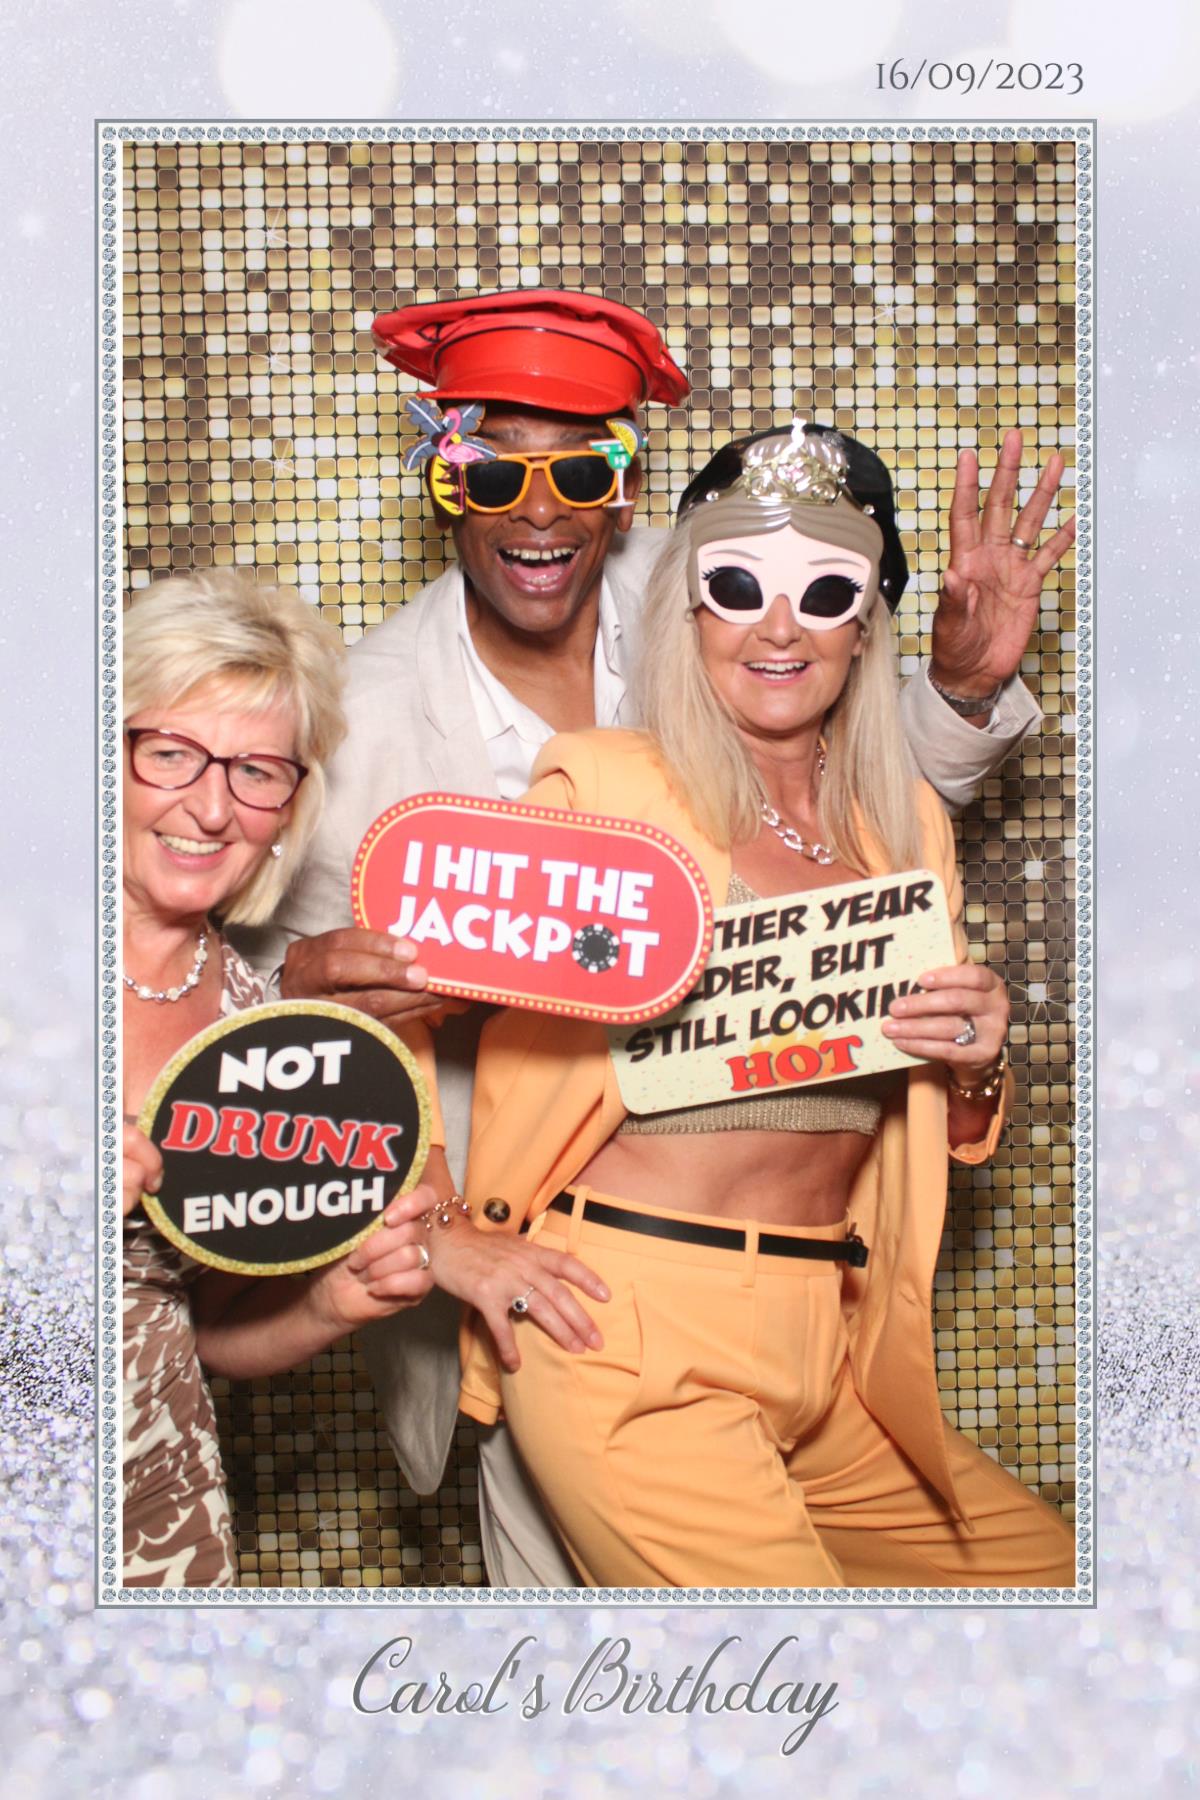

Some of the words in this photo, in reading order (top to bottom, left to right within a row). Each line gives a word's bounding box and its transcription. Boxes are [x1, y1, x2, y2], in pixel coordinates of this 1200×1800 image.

[403, 841, 423, 886] I
[433, 844, 529, 900] HIT
[541, 860, 654, 921] THE
[821, 880, 935, 932] YEAR
[388, 896, 660, 977] JACKPOT
[811, 934, 895, 982] BUT
[625, 1013, 737, 1064] STILL
[749, 979, 922, 1040] LOOKIN
[218, 1040, 351, 1093] NOT
[725, 1034, 863, 1092] HOT
[161, 1100, 403, 1172] DRUNK
[183, 1176, 385, 1234] ENOUGH
